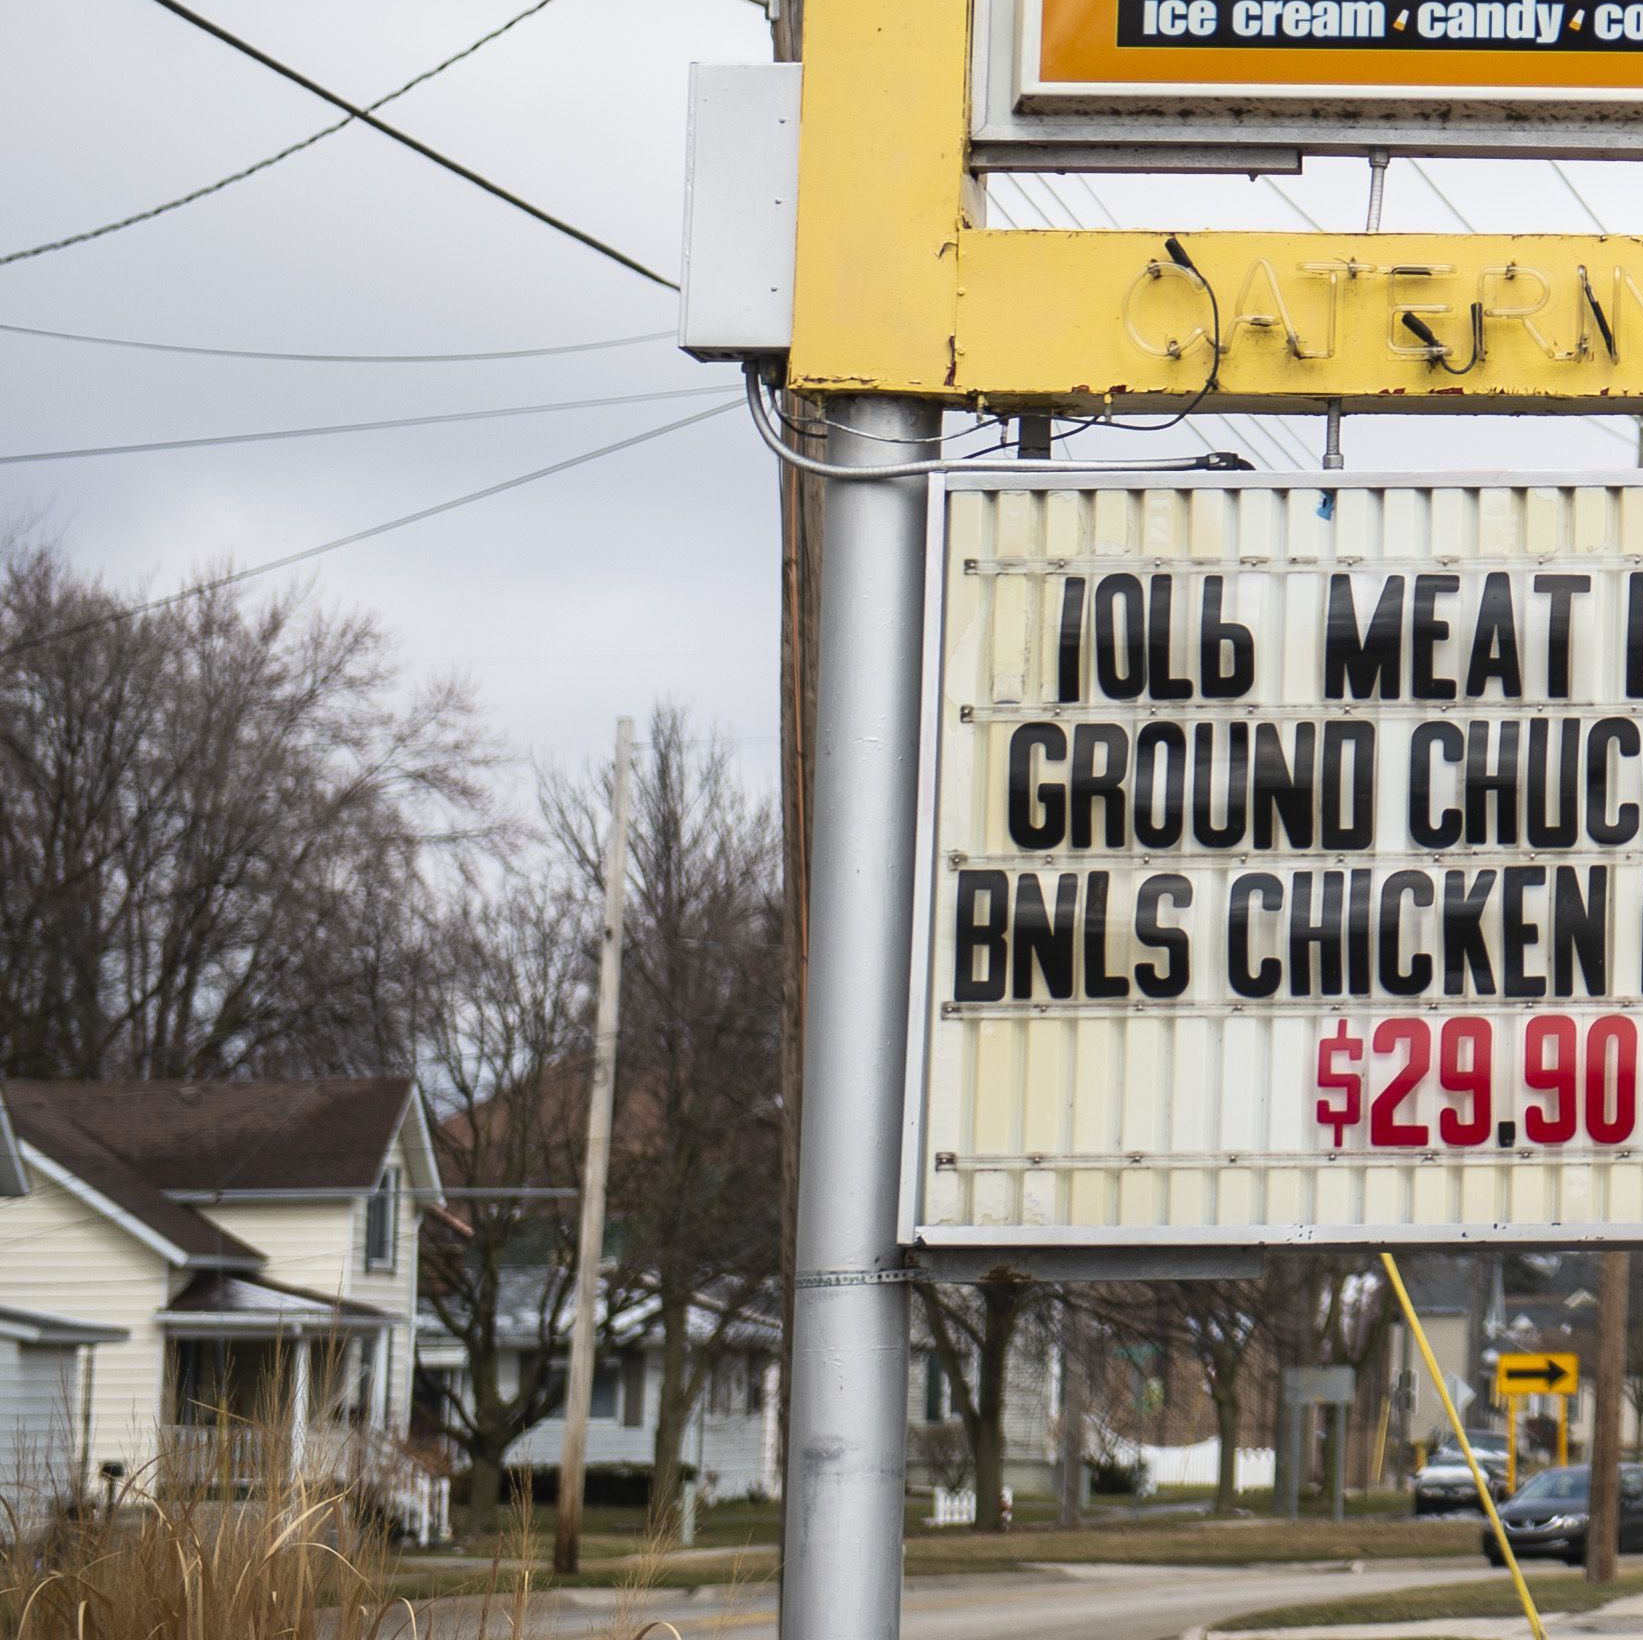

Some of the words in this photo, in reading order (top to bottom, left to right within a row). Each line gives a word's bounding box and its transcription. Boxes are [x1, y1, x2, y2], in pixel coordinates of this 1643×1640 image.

[1323, 573, 1591, 701] MEAT
[1007, 718, 1376, 851] GROUND
[953, 868, 1193, 1003] BNLS
[1226, 864, 1608, 1000] CHICKEN
[1315, 1014, 1639, 1150] $29.90
